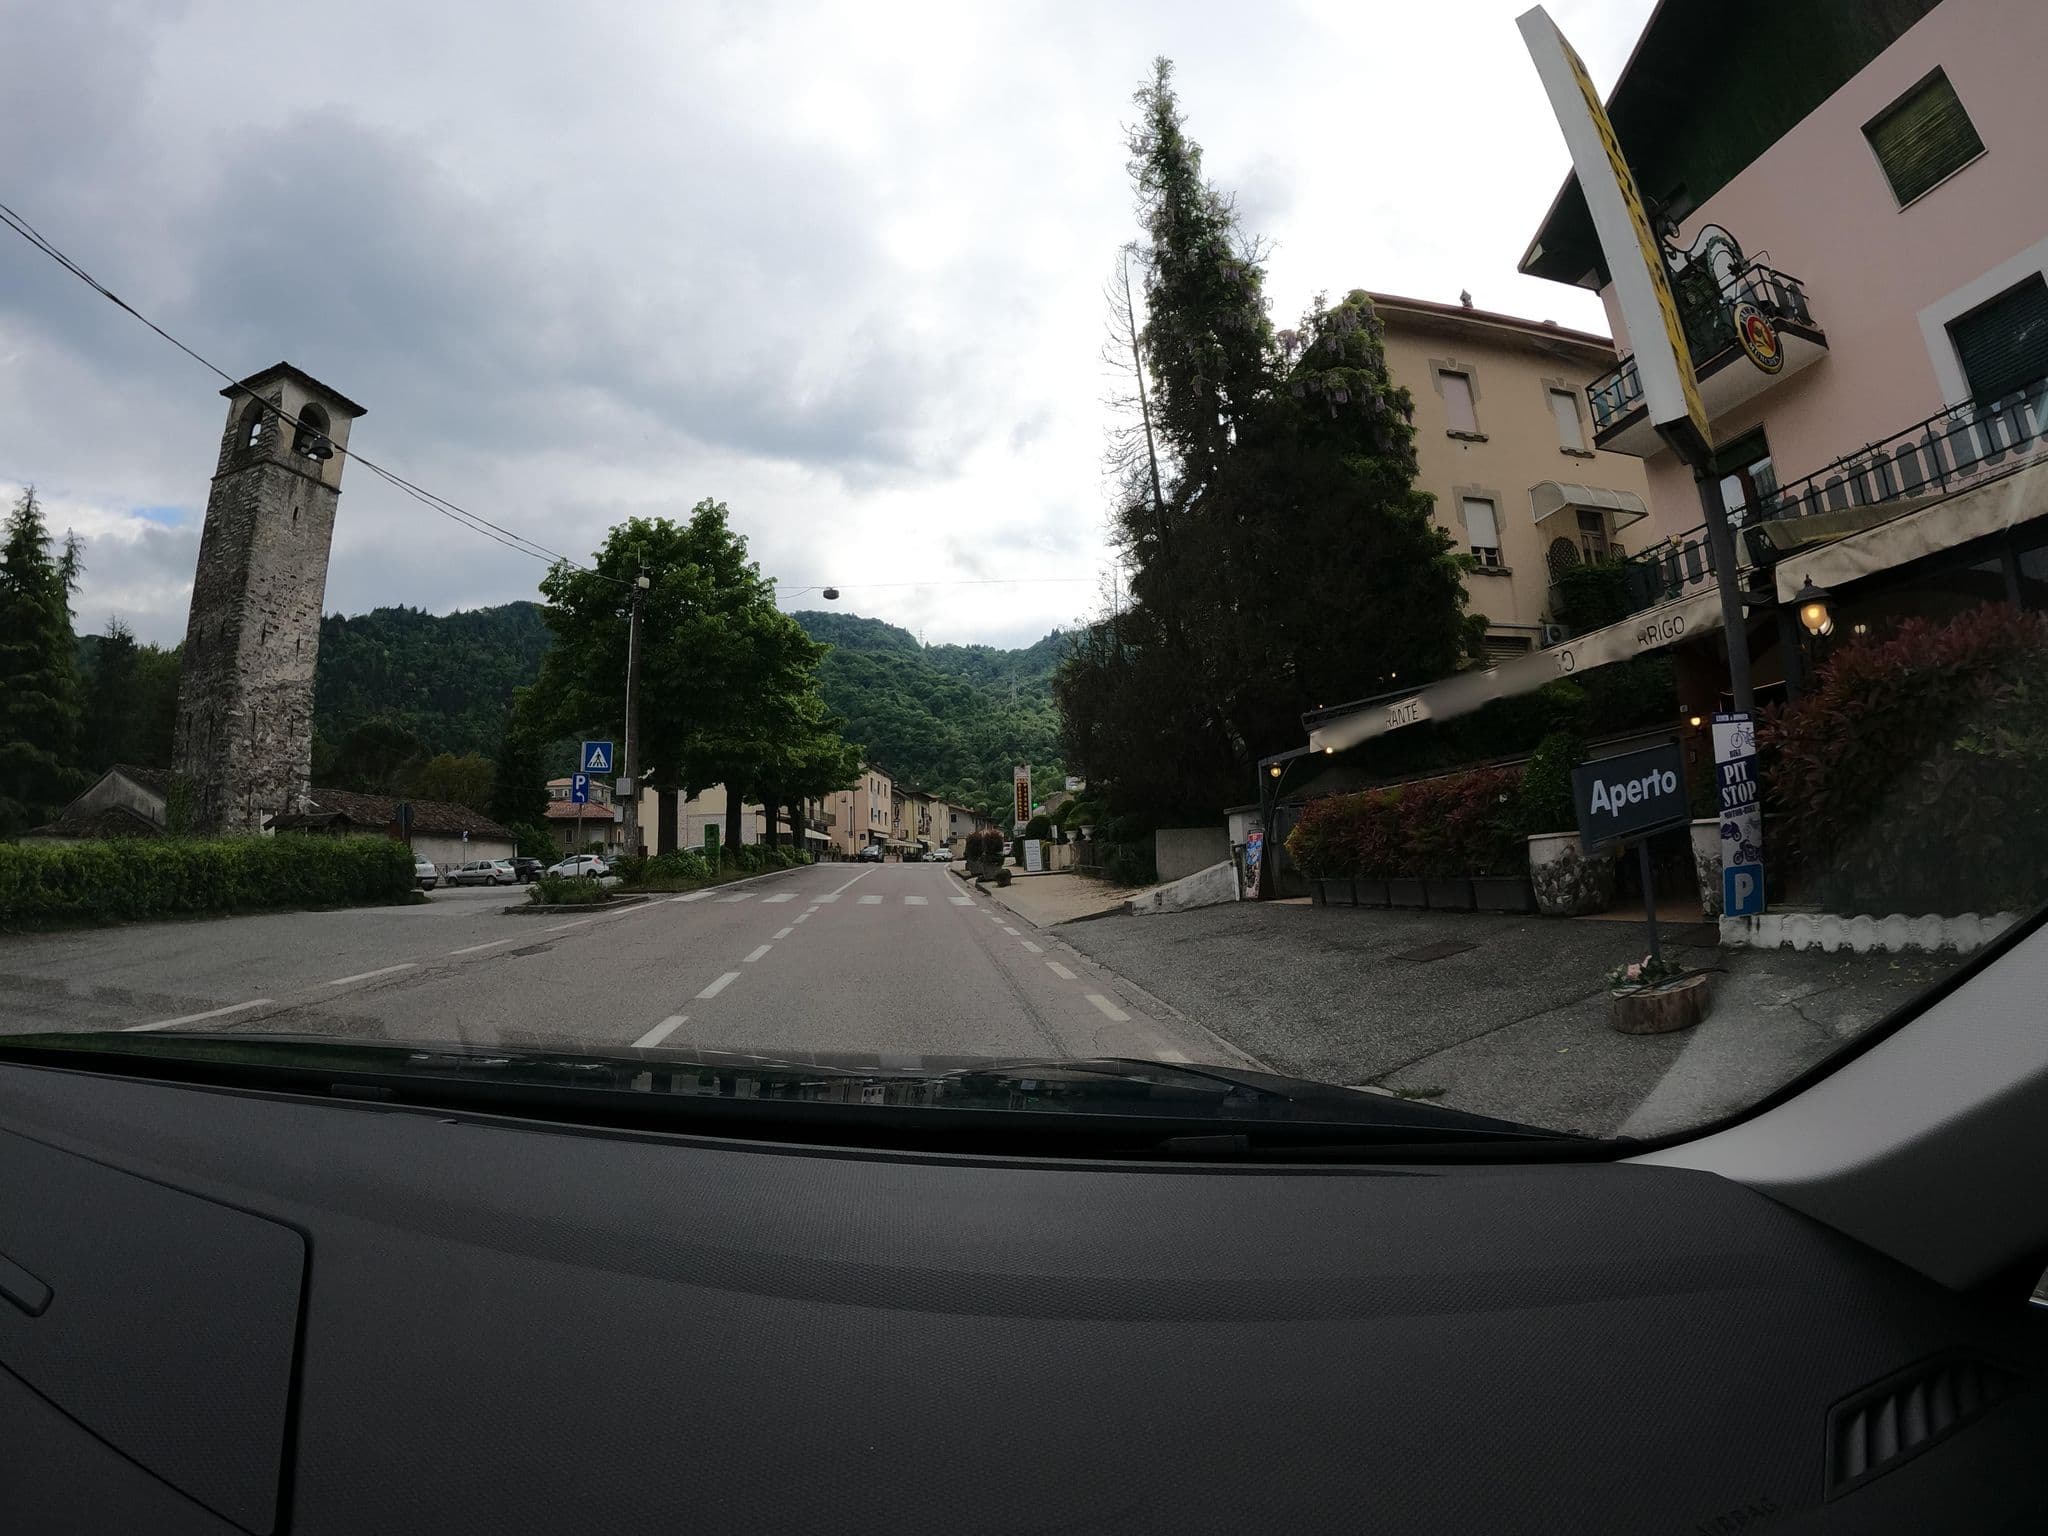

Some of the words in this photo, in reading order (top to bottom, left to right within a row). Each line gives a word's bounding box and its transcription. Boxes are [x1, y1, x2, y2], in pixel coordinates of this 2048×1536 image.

[576, 775, 586, 789] P
[1724, 761, 1748, 784] PIT
[1590, 768, 1677, 818] Aperto
[1722, 780, 1757, 807] STOP
[1734, 873, 1754, 910] P
